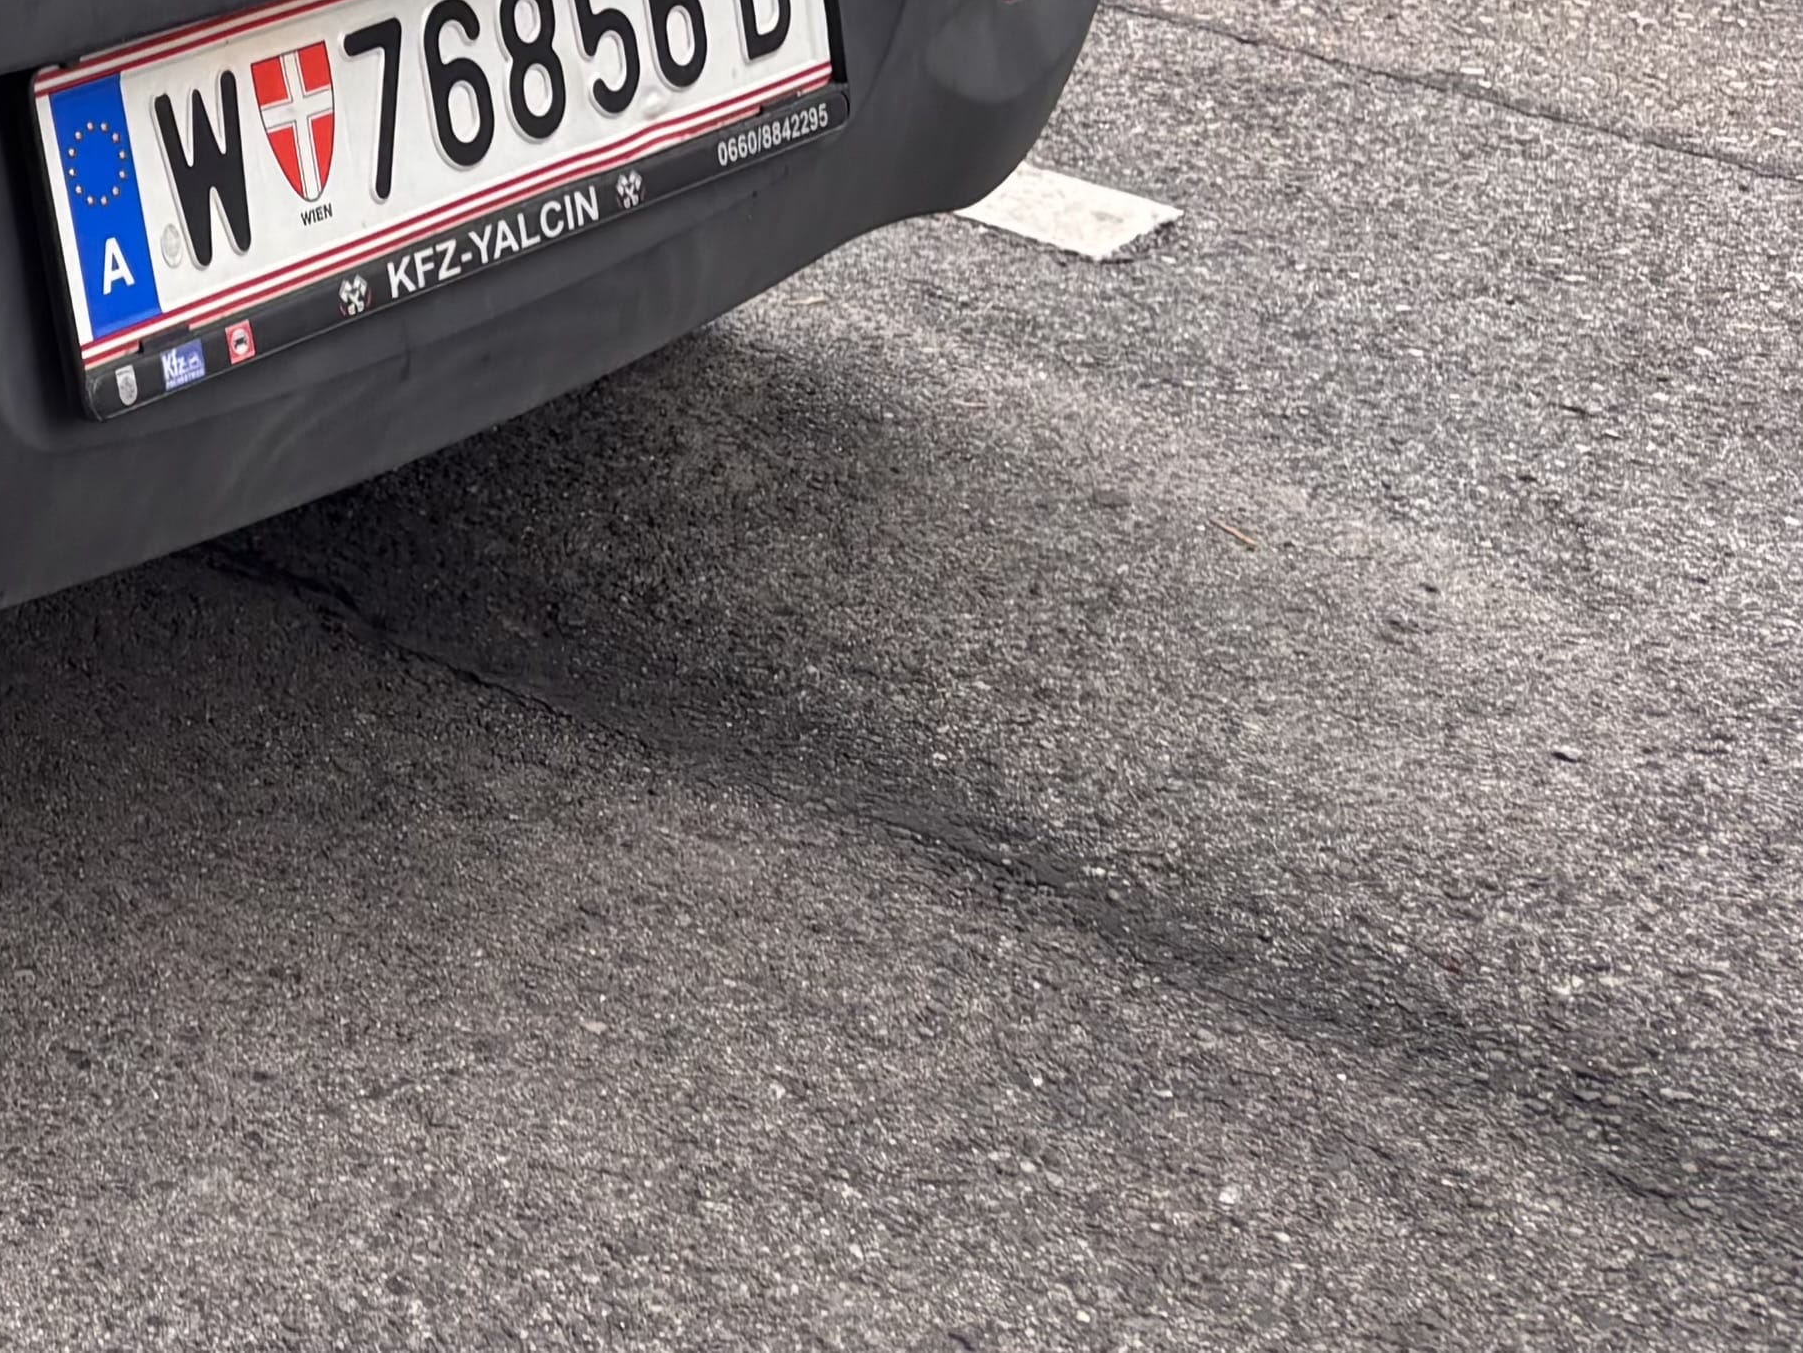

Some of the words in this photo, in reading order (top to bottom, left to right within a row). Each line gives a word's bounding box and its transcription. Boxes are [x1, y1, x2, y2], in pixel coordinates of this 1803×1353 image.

[717, 102, 829, 167] 0660/8842295
[154, 70, 251, 268] W
[300, 204, 334, 226] WIEN
[386, 187, 600, 299] KFZ-YALCIN
[102, 237, 133, 296] A
